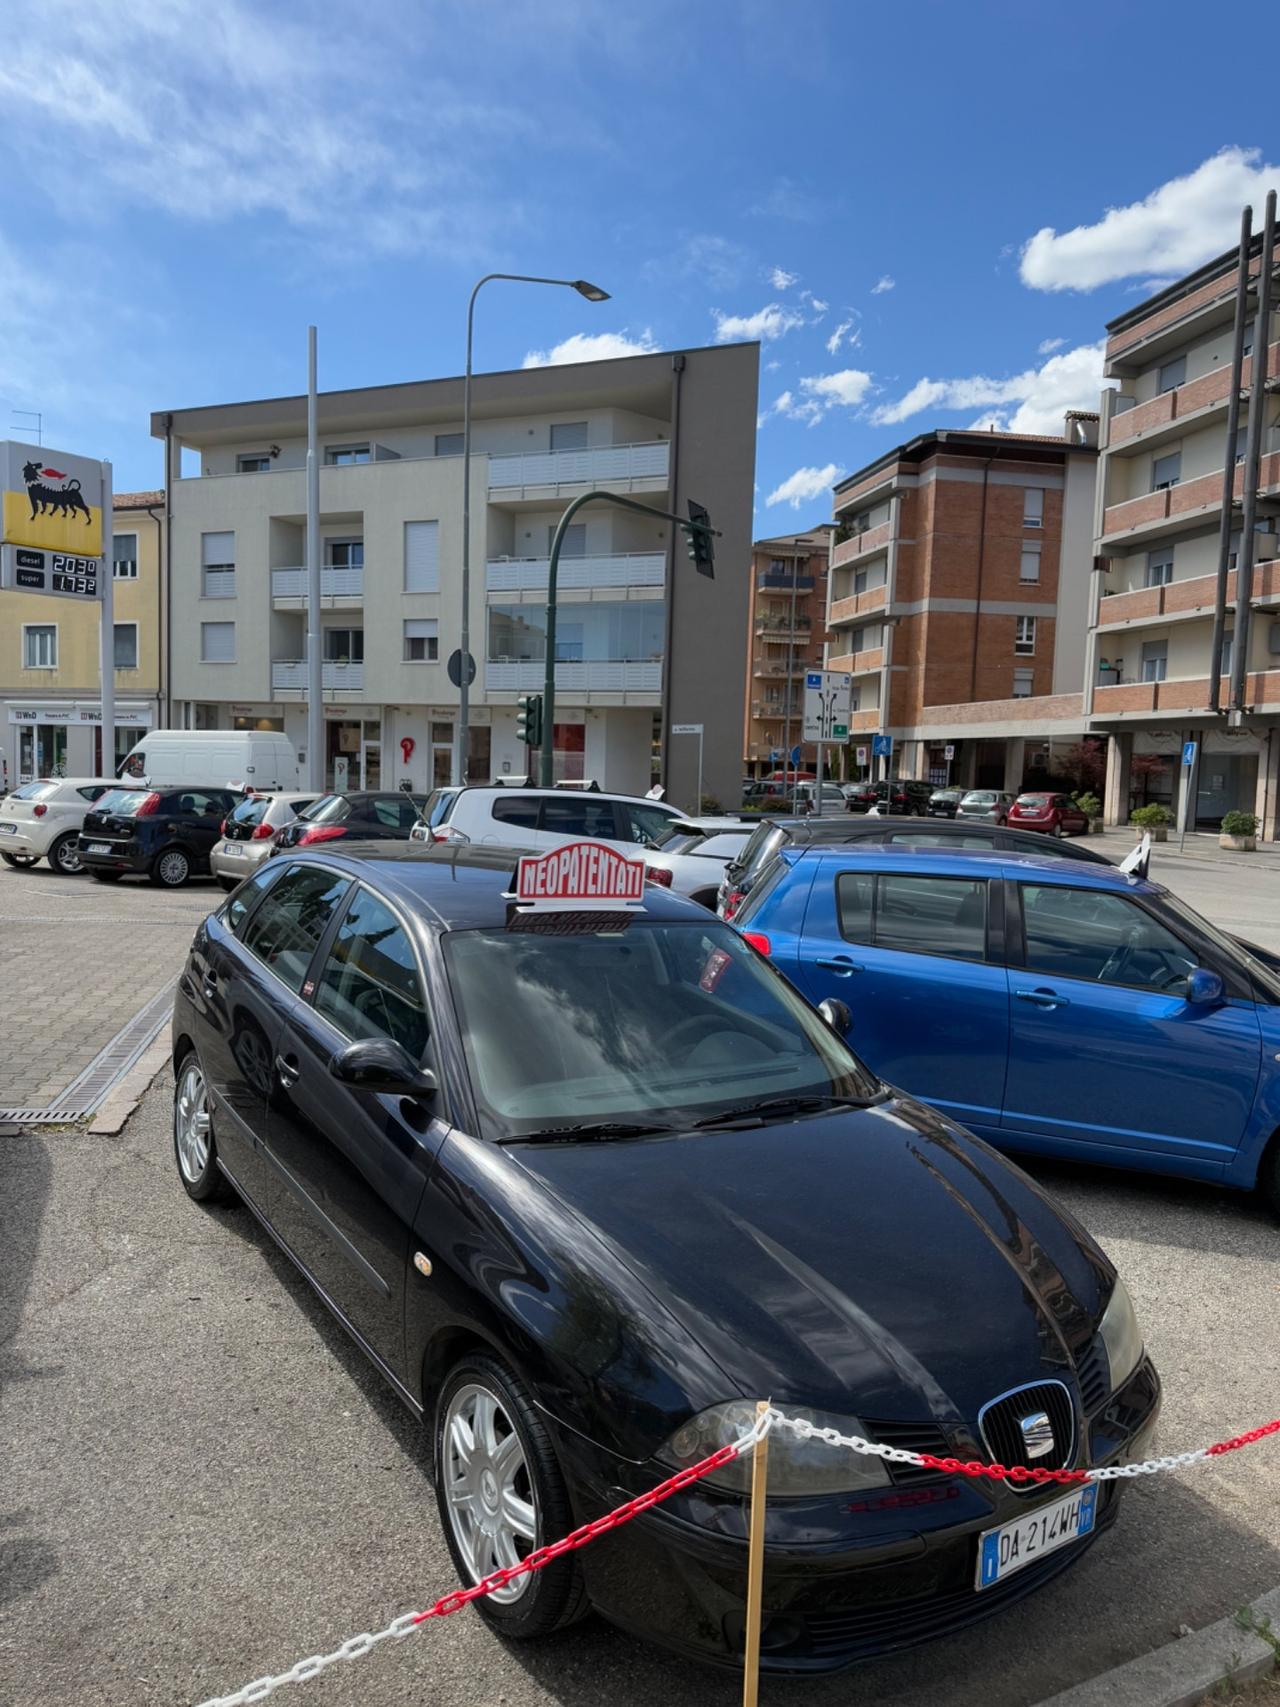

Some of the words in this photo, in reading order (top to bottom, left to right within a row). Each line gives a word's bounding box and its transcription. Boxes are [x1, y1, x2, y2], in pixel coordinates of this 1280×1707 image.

[20, 556, 40, 565] diesel
[21, 574, 40, 583] super
[523, 845, 641, 895] NEOPATENTATI
